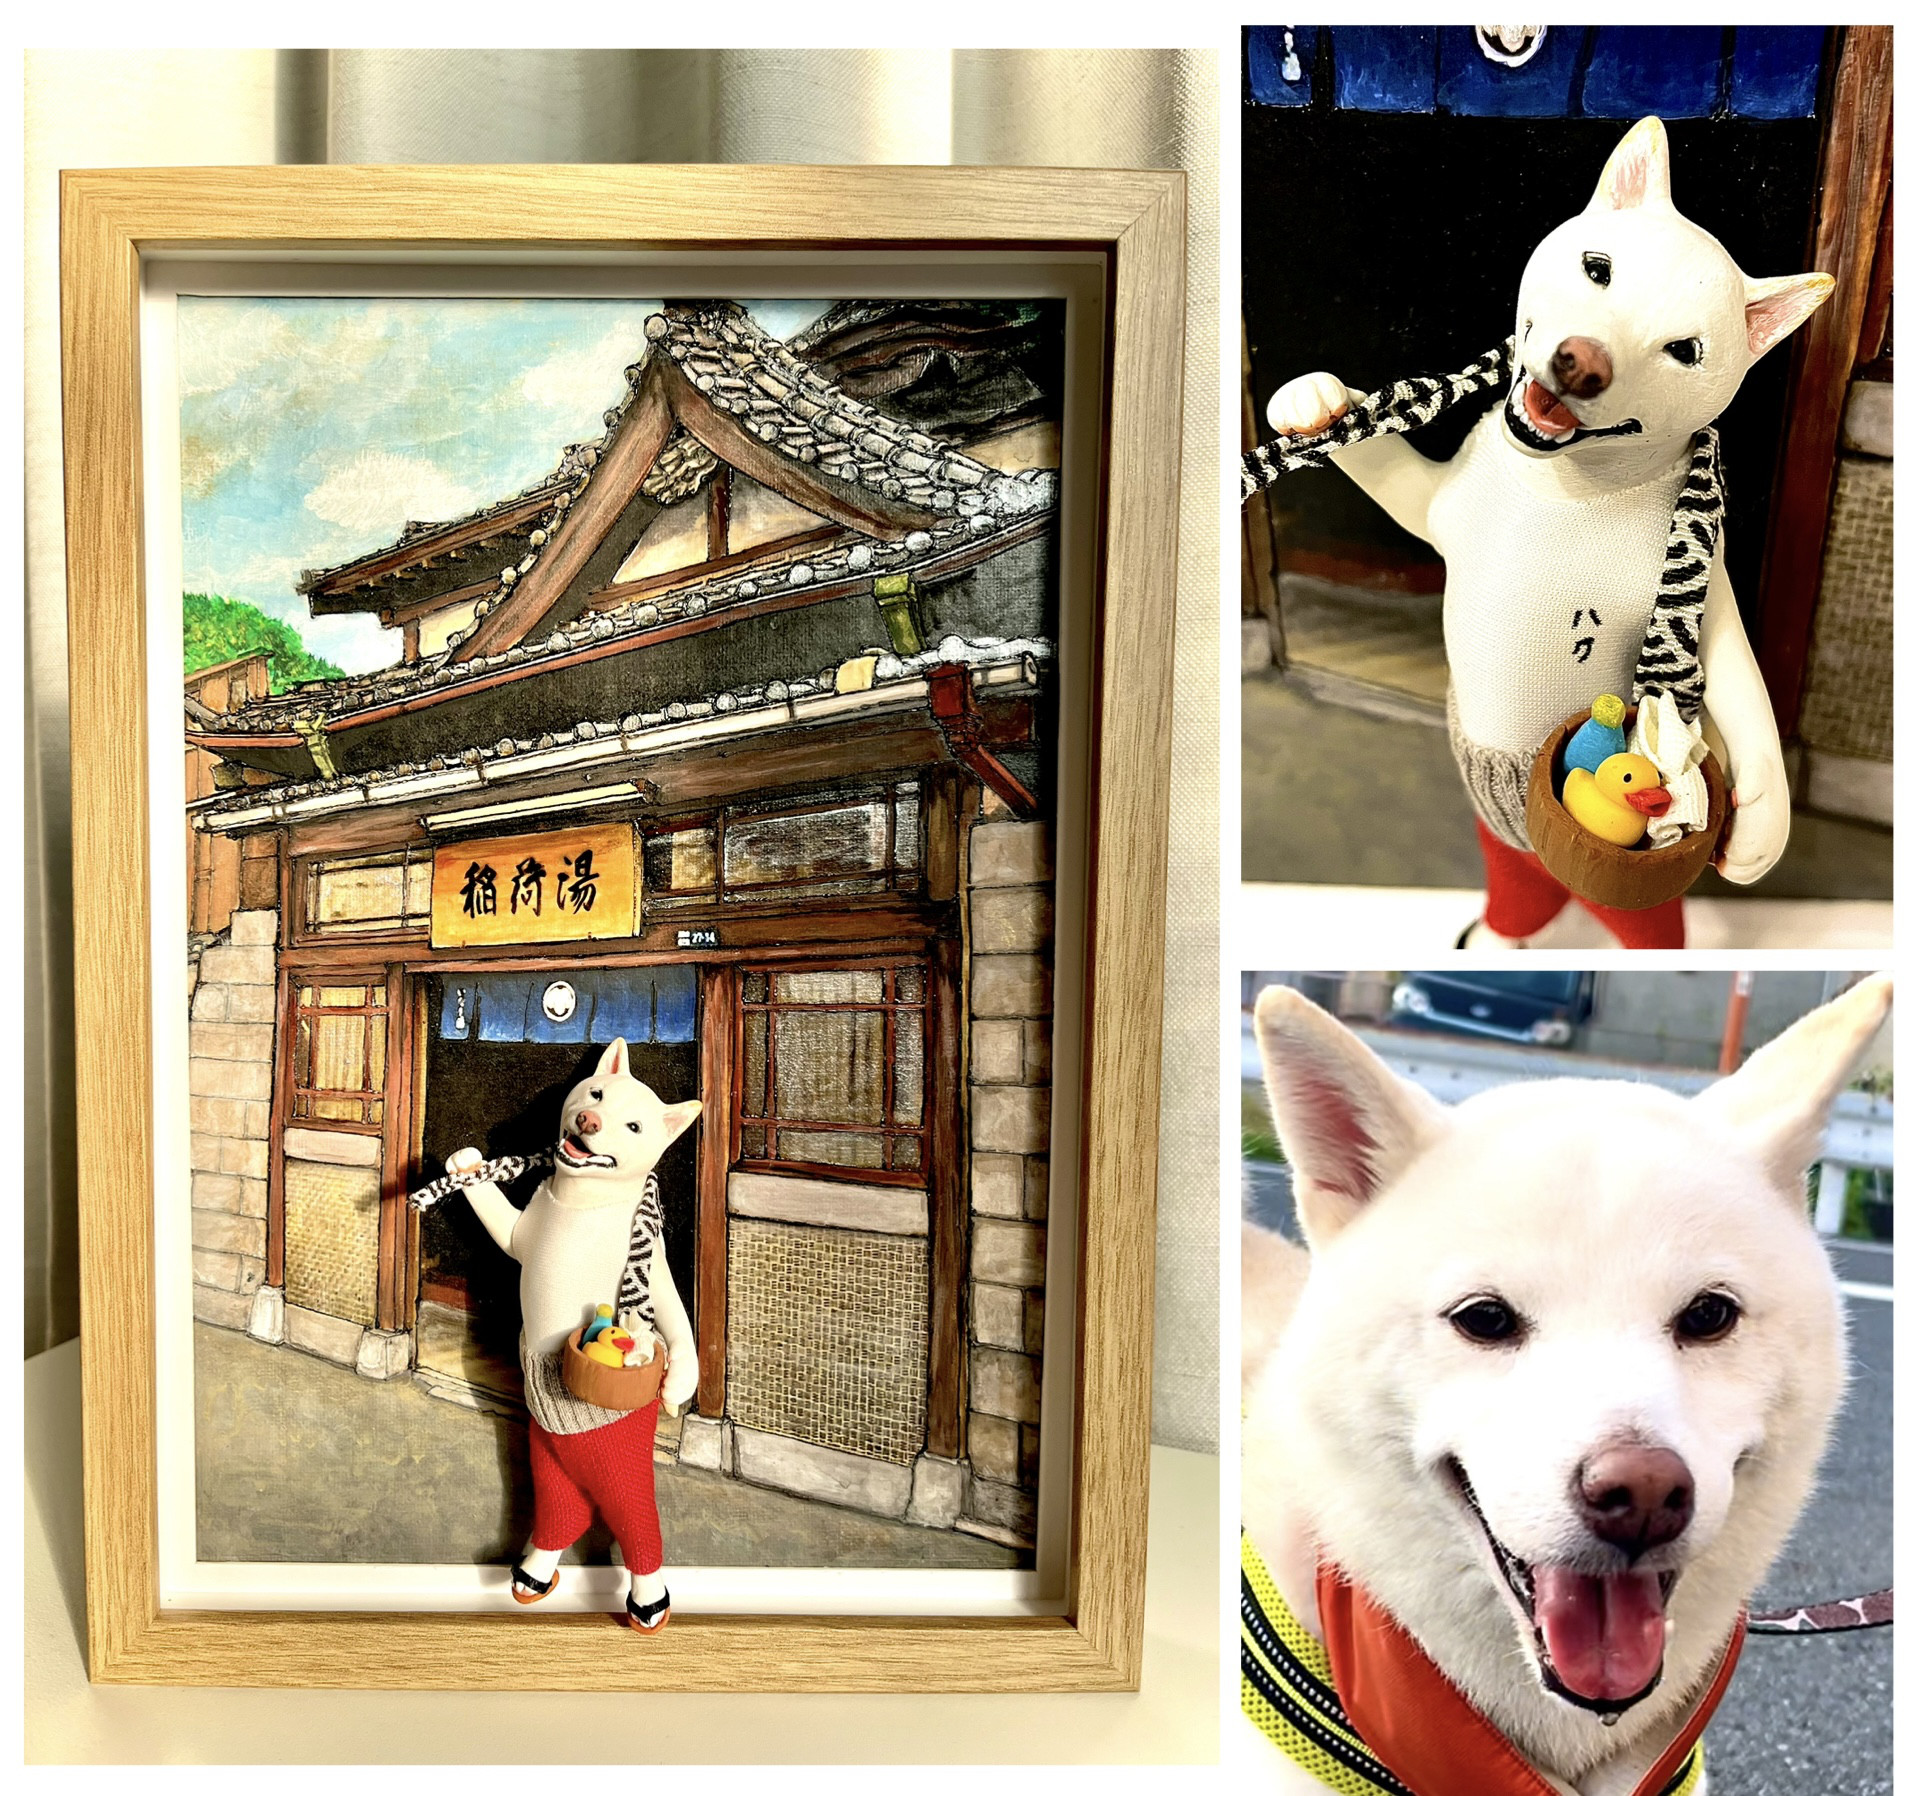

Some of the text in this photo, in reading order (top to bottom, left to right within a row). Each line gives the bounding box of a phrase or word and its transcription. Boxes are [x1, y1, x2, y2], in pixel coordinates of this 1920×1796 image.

[1571, 608, 1602, 664] ハク
[460, 849, 600, 919] 稲荷湯
